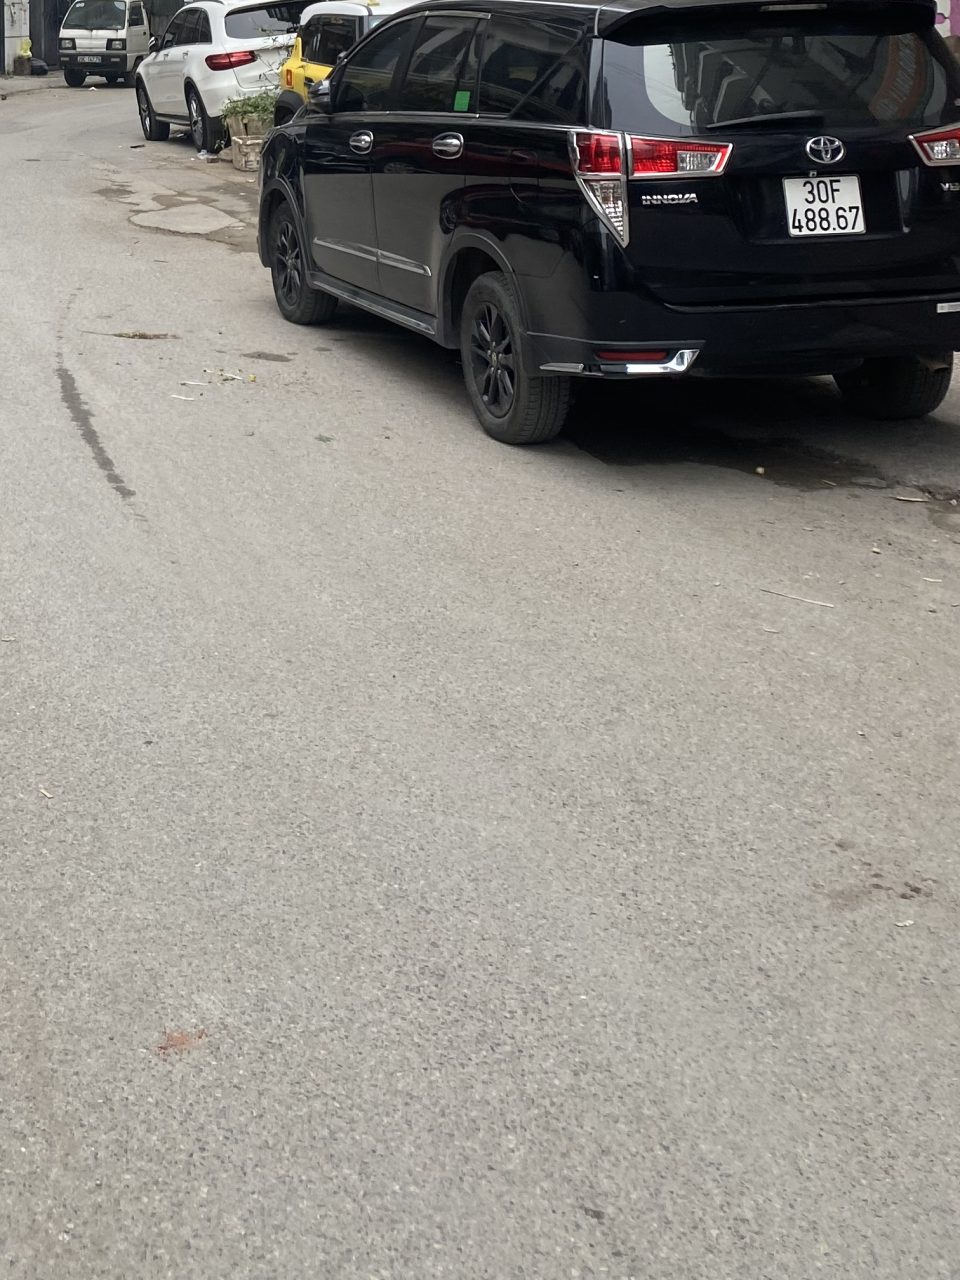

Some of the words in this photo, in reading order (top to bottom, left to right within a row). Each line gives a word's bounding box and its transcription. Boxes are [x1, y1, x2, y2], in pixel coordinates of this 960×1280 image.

[641, 193, 698, 205] INNOVA
[803, 179, 841, 204] 30F
[792, 206, 860, 233] 488.67
